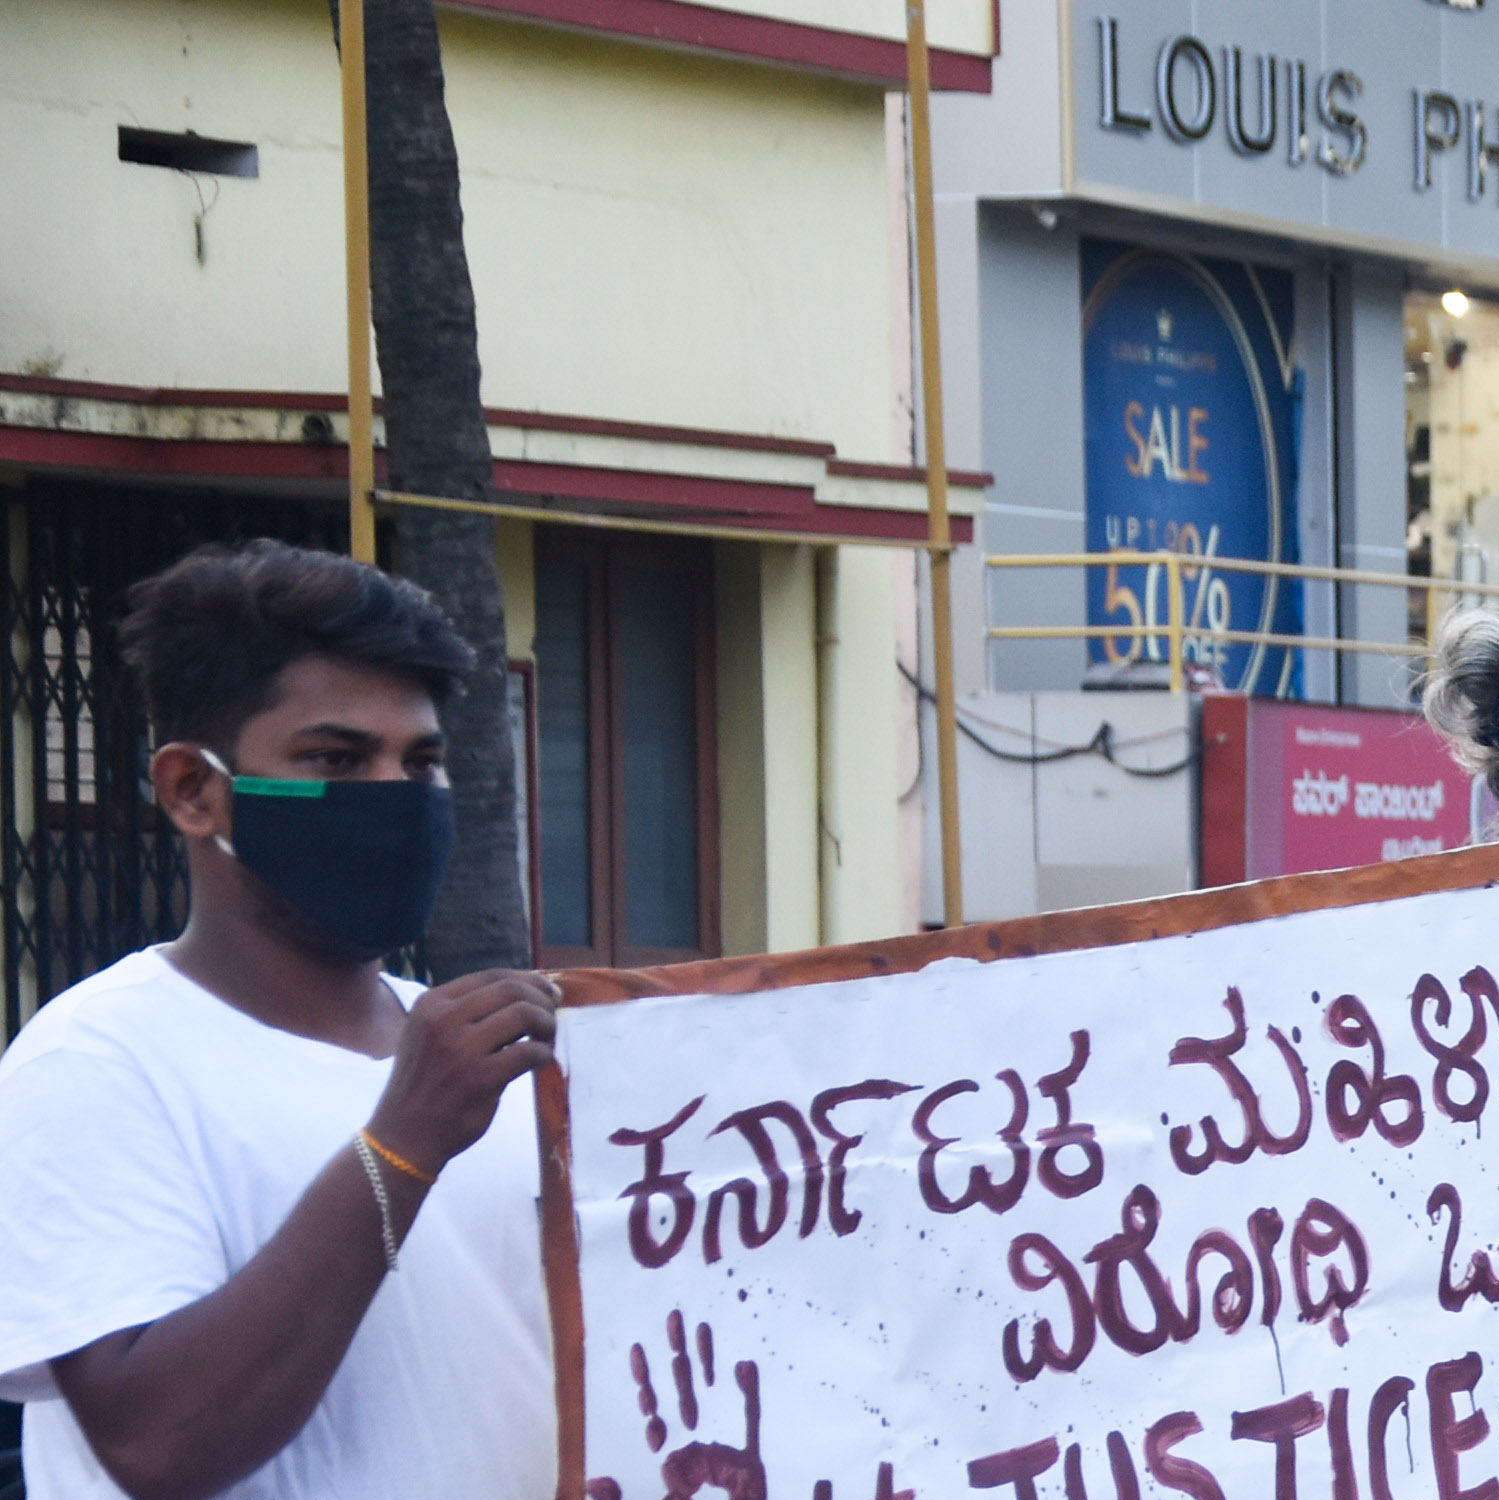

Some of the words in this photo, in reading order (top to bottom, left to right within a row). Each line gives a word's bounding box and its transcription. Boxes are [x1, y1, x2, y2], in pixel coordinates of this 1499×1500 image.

[1097, 15, 1368, 178] LOUIS
[1124, 400, 1210, 485] SALE
[1001, 1184, 1370, 1383] ವಿರೋಧಿ
